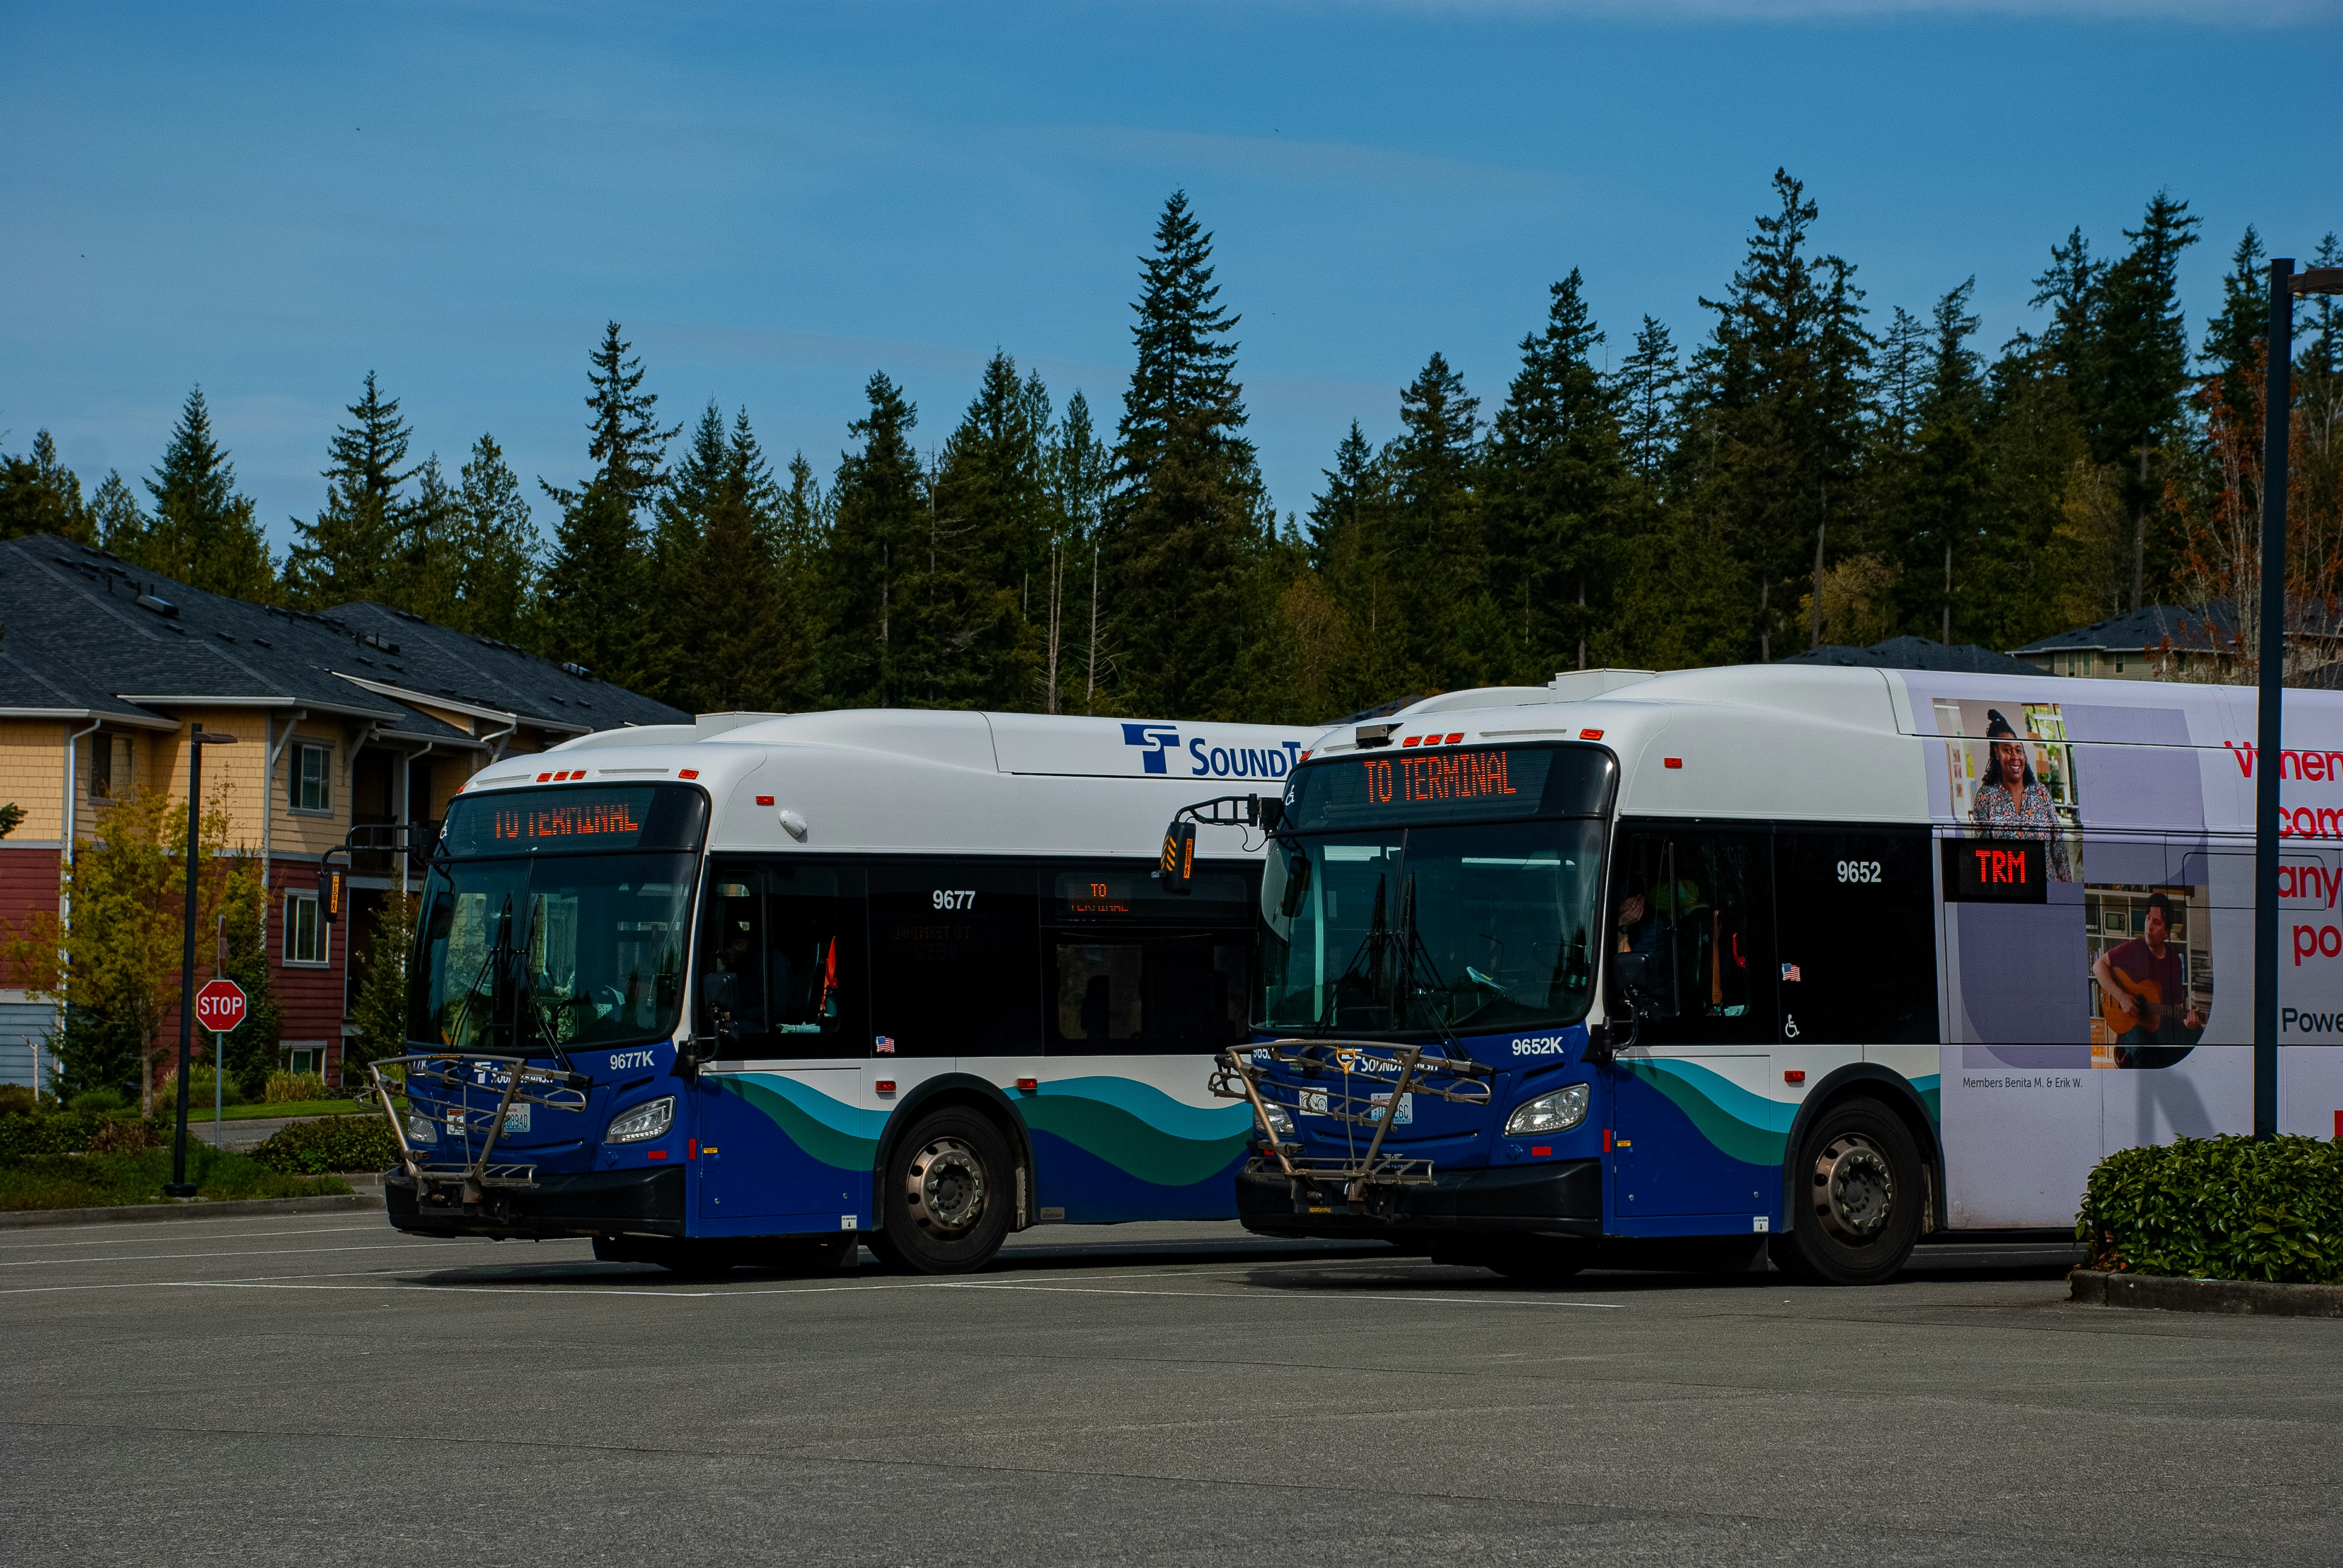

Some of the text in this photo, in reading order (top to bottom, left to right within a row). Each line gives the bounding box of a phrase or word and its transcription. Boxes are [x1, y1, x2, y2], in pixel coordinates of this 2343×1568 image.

[1189, 737, 1306, 777] SOUNDT
[1364, 751, 1516, 803] TO TERMINAL
[1837, 860, 1882, 883] 9652
[1975, 849, 2026, 884] TRM
[1090, 883, 1107, 897] TO
[2278, 865, 2342, 909] any
[932, 890, 976, 909] 9677
[200, 996, 243, 1016] STOP
[1512, 1036, 1564, 1056] 9652K
[610, 1050, 655, 1070] 9677K
[1963, 1077, 2083, 1088] Members Benita M. & Erik W.
